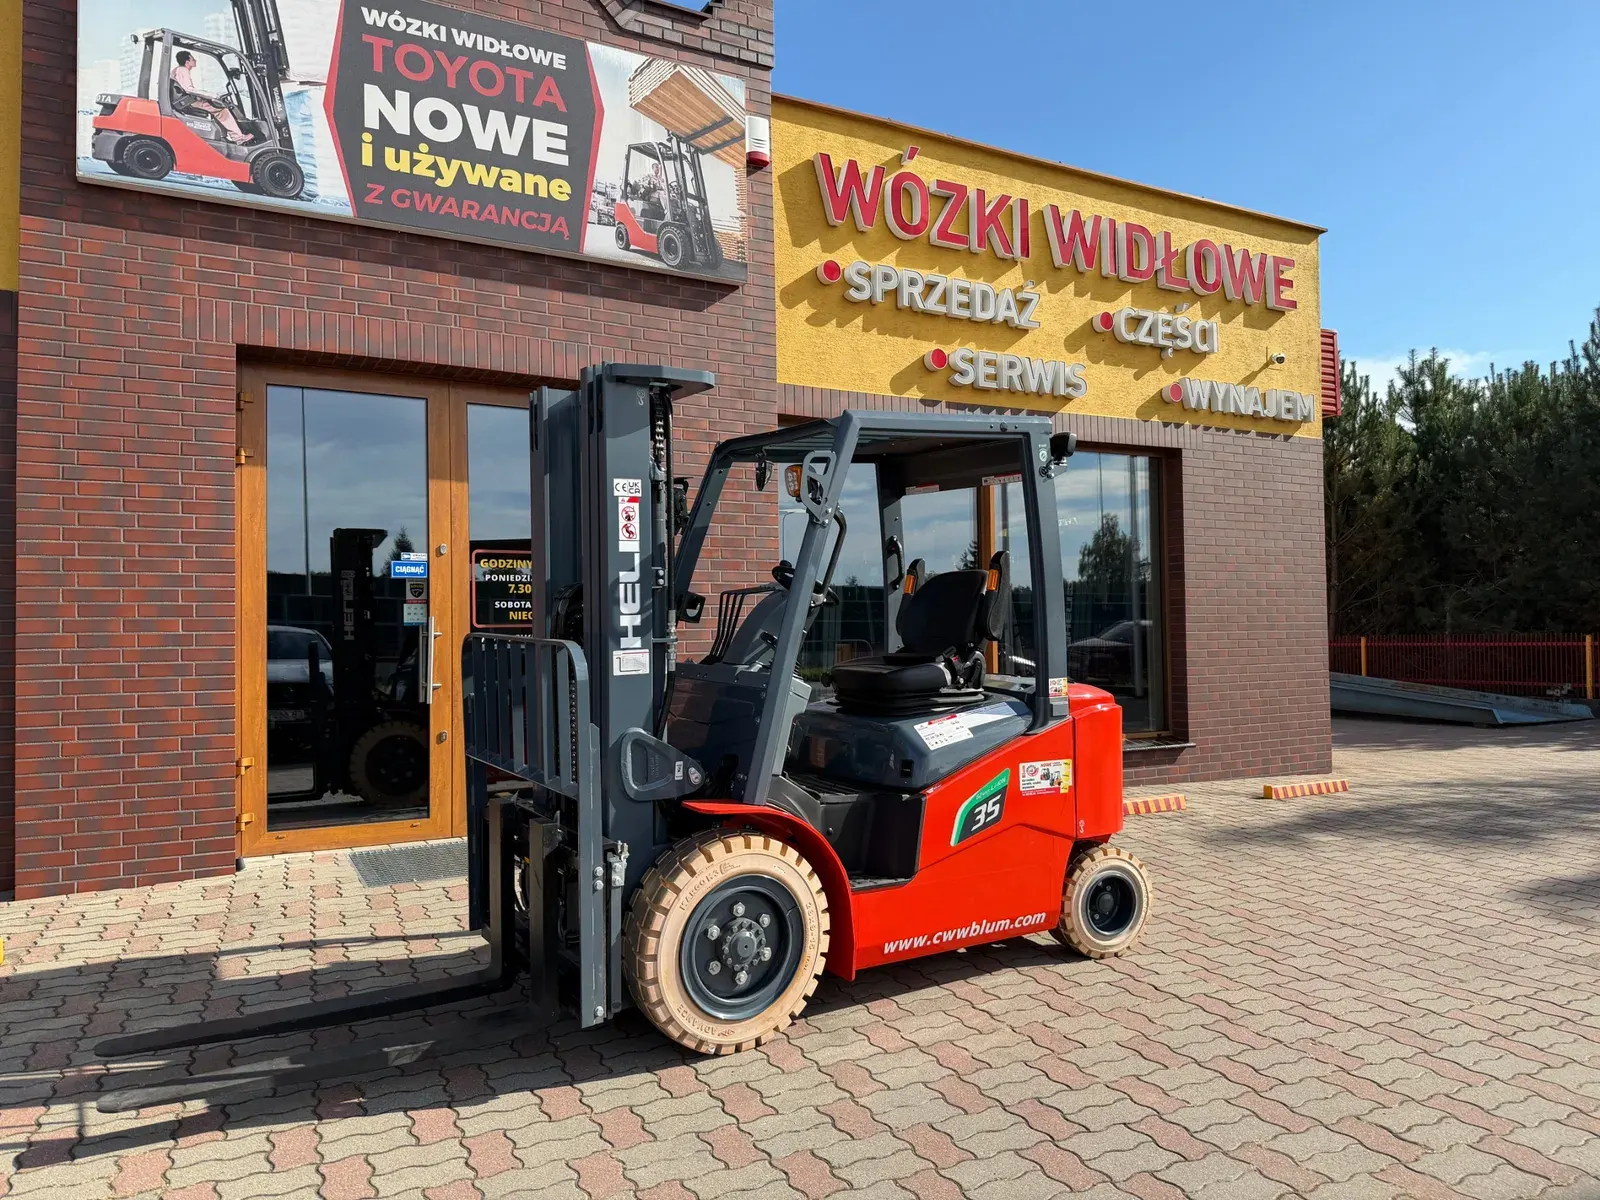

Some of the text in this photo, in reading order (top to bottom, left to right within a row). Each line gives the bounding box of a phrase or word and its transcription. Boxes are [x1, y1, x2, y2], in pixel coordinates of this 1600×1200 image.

[361, 6, 567, 70] WÓZKI WIDŁOWE
[362, 33, 567, 112] TOYOTA
[364, 83, 569, 166] NOWE
[361, 132, 572, 202] i używane
[363, 183, 570, 240] Z GWARANCJĄ
[813, 145, 1298, 312] WÓZKI WIDŁOWE
[844, 260, 1041, 330] SPRZEDAŻ
[1113, 302, 1218, 359] CZĘŚCI
[947, 347, 1087, 399] SERWIS
[1179, 377, 1316, 422] WYNAJEM
[395, 565, 425, 575] CIĄGNĄĆ
[485, 574, 532, 582] PONIEDZI
[508, 583, 532, 594] 7.30
[619, 541, 641, 649] HELI
[494, 601, 532, 609] SOBOTA
[971, 794, 1001, 831] 35
[883, 911, 1047, 954] www.cwwblum.com
